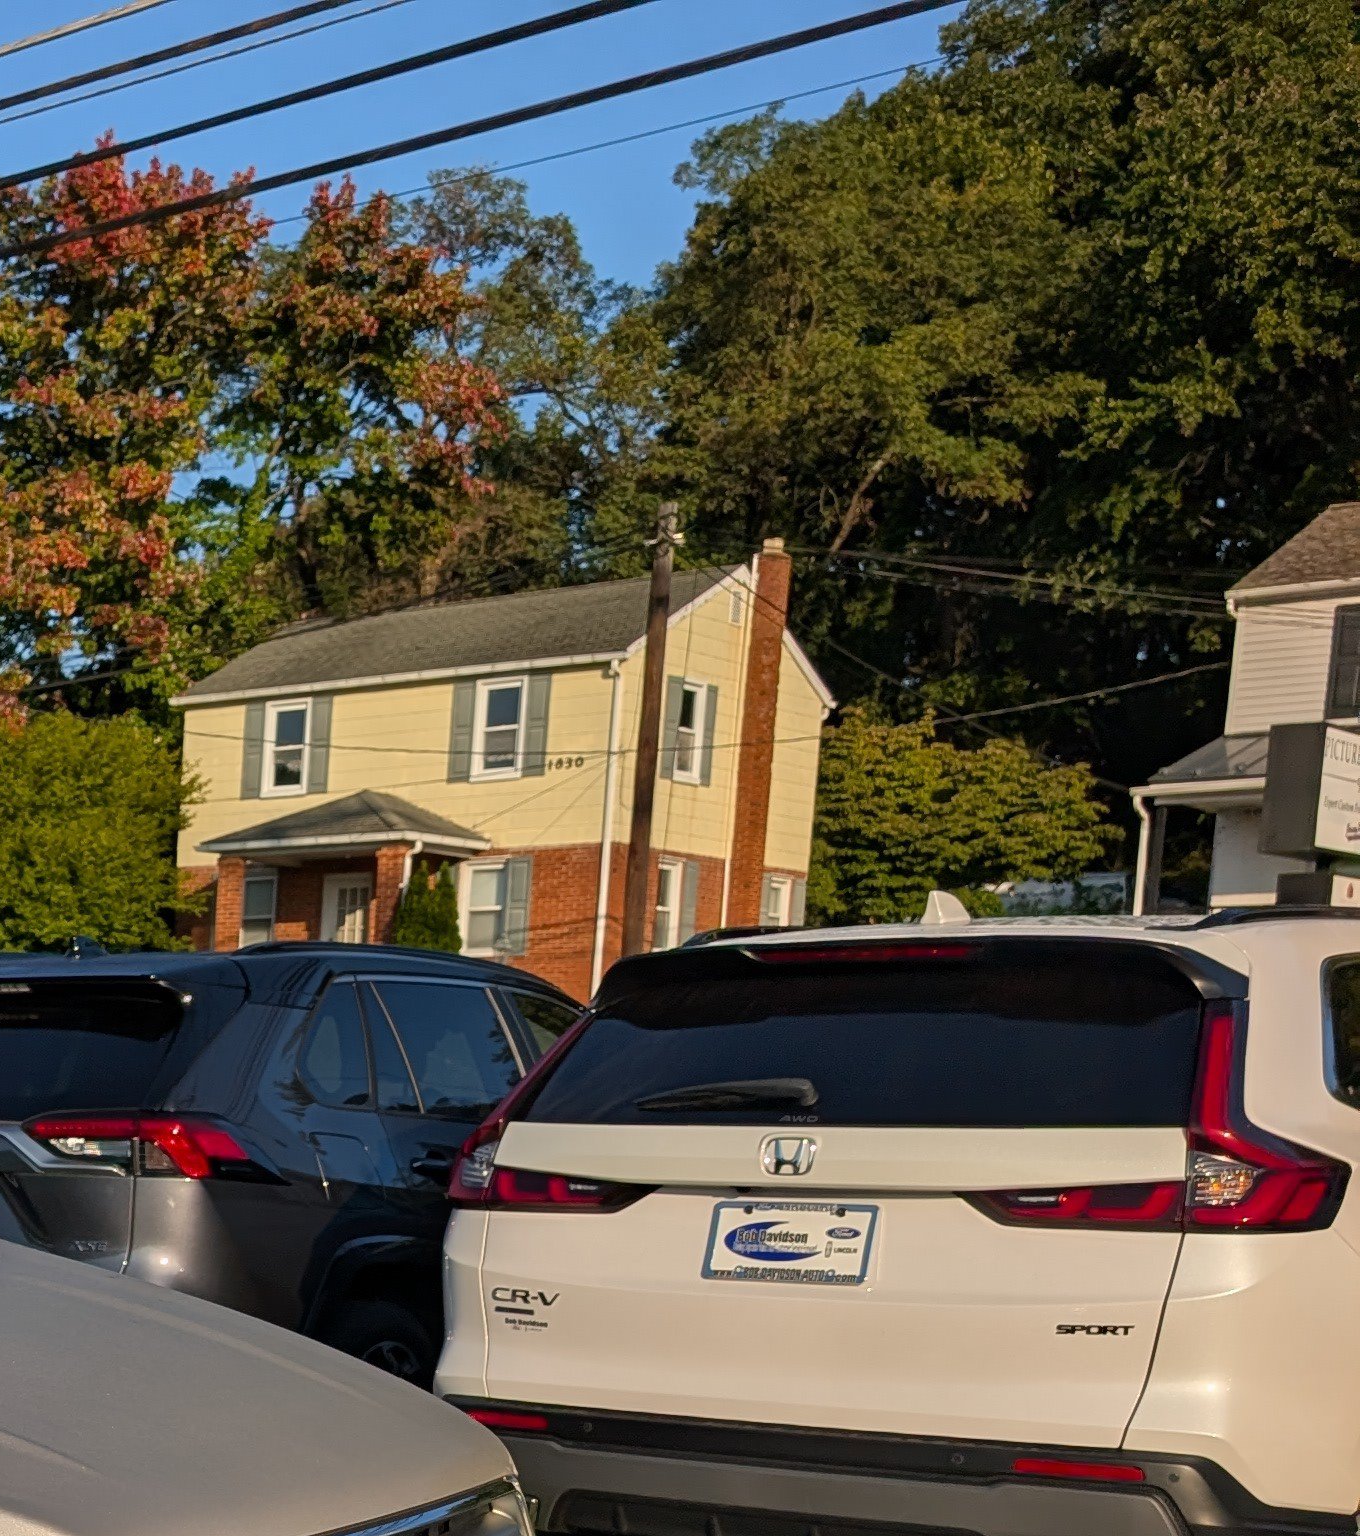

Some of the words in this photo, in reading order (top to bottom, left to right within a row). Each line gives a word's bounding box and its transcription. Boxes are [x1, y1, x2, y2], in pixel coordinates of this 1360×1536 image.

[779, 1114, 819, 1123] AWD
[736, 1229, 758, 1243] Bob
[760, 1230, 809, 1244] Davidson
[833, 1247, 858, 1255] LINCOLN
[491, 1287, 560, 1307] CR-V
[1055, 1324, 1136, 1336] SPORT
